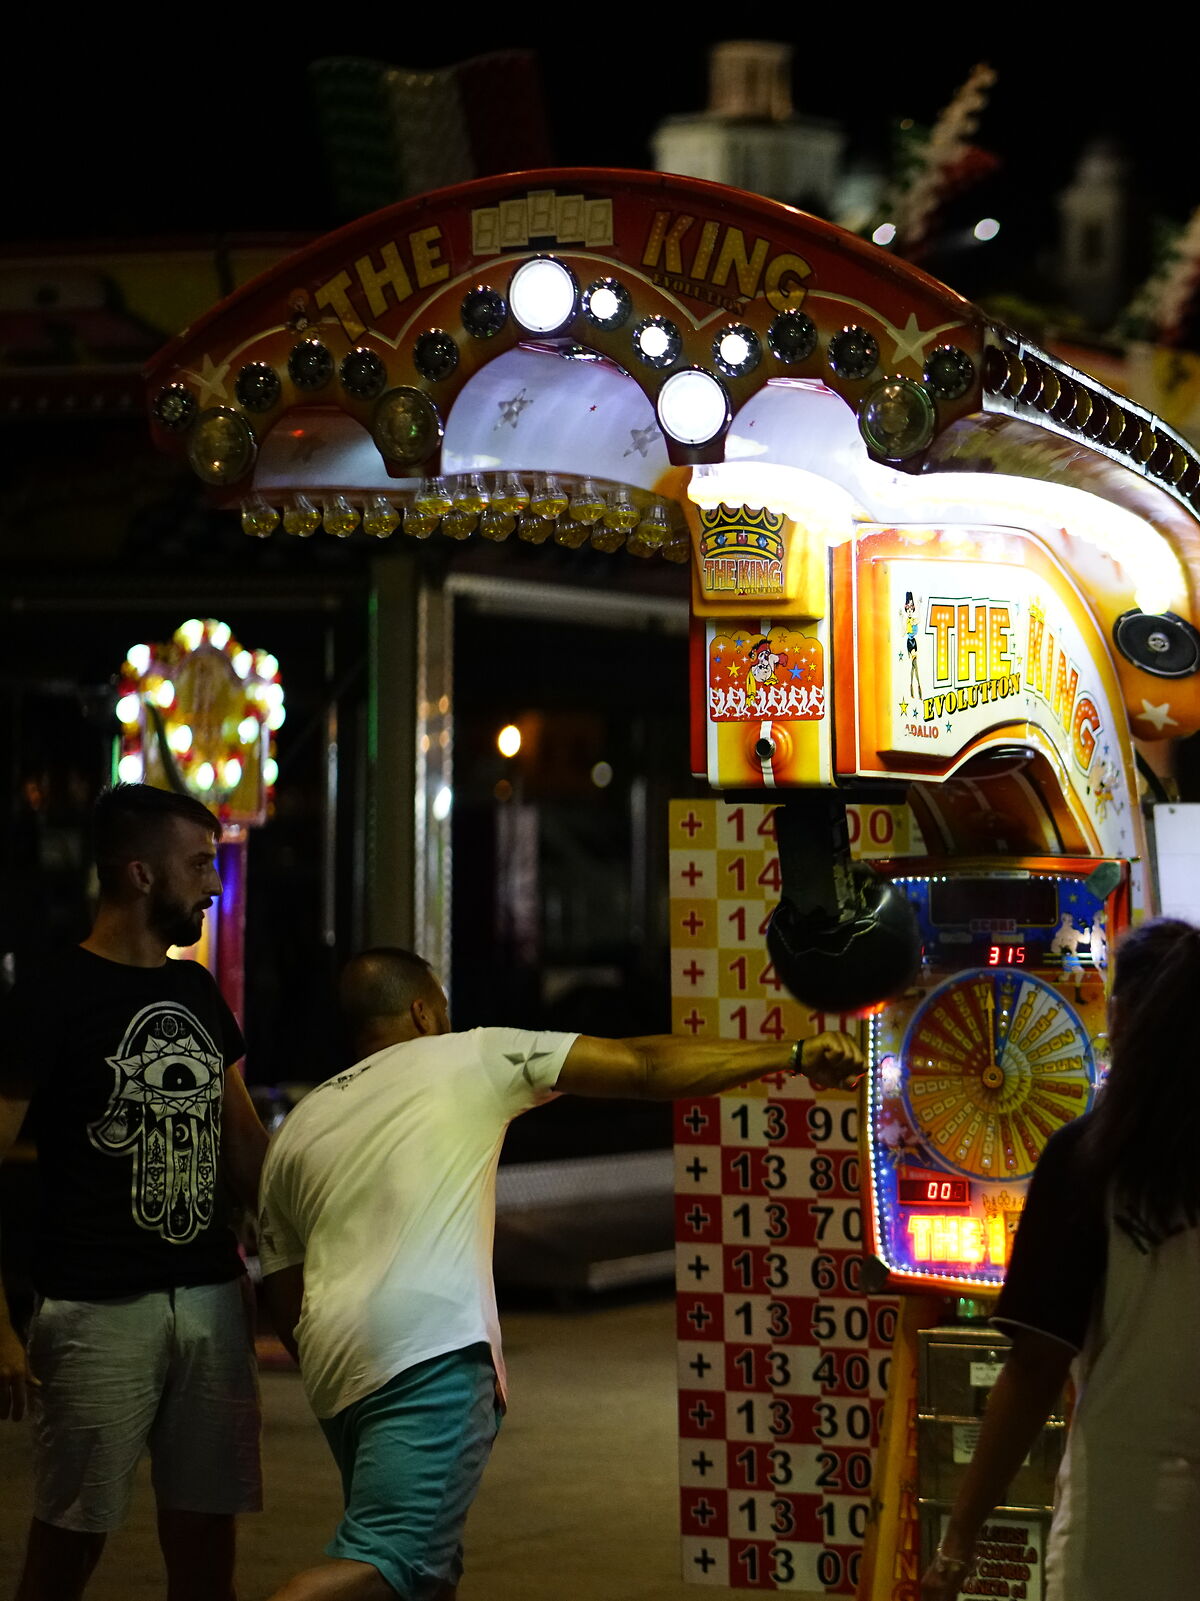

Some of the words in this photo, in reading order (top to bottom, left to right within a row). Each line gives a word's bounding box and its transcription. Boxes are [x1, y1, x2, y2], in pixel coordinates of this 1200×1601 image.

[315, 226, 451, 342] THE
[642, 211, 812, 313] KING
[703, 559, 737, 590] THE
[737, 558, 782, 590] KING
[923, 672, 1021, 721] EVOLUTION
[927, 599, 1014, 687] THE
[1024, 606, 1104, 776] KING
[681, 813, 702, 837] +
[681, 862, 703, 886] +
[728, 857, 782, 892] 14
[682, 911, 704, 936] +
[683, 961, 704, 985] +
[729, 956, 782, 991] 14
[987, 946, 1025, 965] 315
[684, 1010, 705, 1033] +
[729, 1006, 784, 1040] 14
[1008, 991, 1038, 1045] 1000
[1018, 1007, 1058, 1052] 1500
[684, 1107, 707, 1133] +
[731, 1104, 787, 1140] 13
[807, 1107, 859, 1142] 90
[685, 1156, 708, 1183] +
[731, 1153, 787, 1190] 13
[810, 1156, 860, 1192] 80
[687, 1206, 709, 1232] +
[733, 1203, 788, 1239] 13
[810, 1206, 862, 1242] 70
[908, 1215, 985, 1263] THE
[687, 1255, 710, 1280] +
[734, 1253, 790, 1288] 13
[811, 1255, 863, 1291] 60
[688, 1304, 710, 1330] +
[735, 1302, 791, 1337] 13
[689, 1353, 711, 1378] +
[736, 1350, 791, 1387] 13
[690, 1402, 713, 1427] +
[737, 1399, 792, 1436] 13
[814, 1403, 884, 1440] 30
[691, 1450, 713, 1476] +
[737, 1448, 793, 1485] 13
[815, 1452, 872, 1489] 20
[692, 1500, 714, 1524] +
[739, 1497, 794, 1534] 13
[816, 1501, 869, 1538] 10
[694, 1548, 716, 1574] +
[739, 1546, 796, 1583] 13
